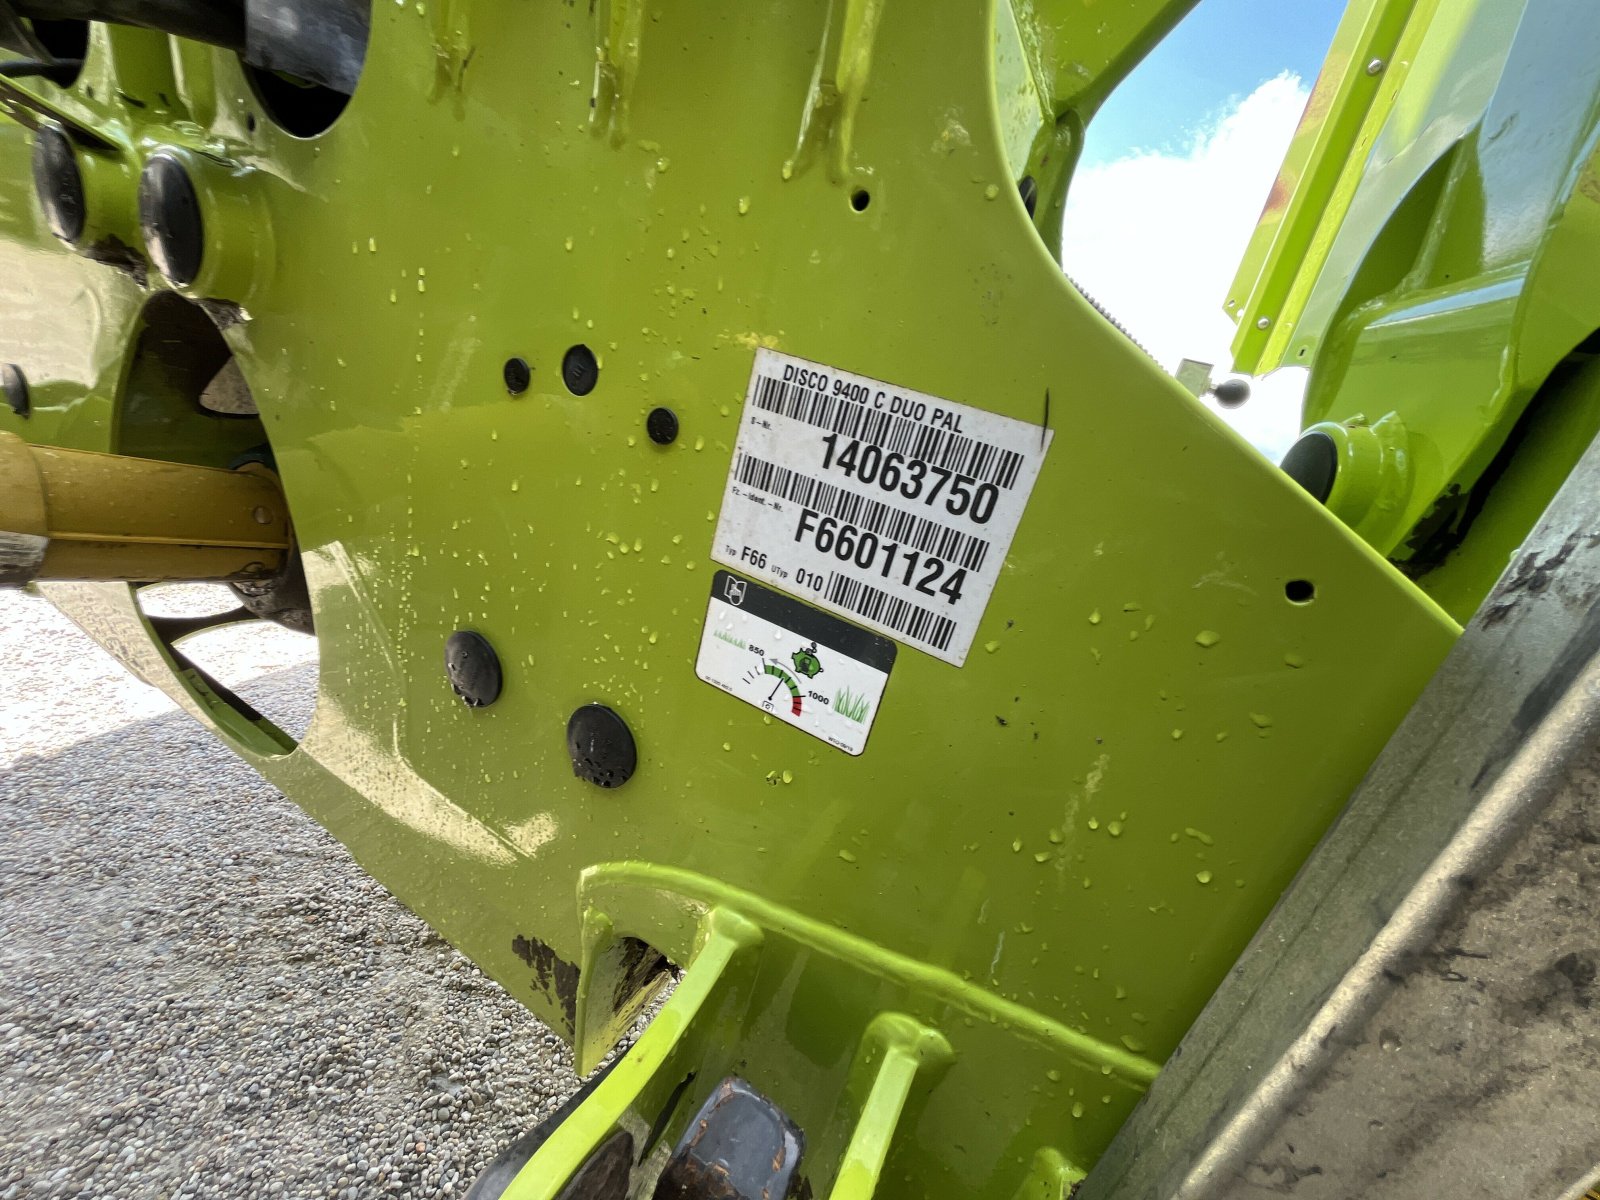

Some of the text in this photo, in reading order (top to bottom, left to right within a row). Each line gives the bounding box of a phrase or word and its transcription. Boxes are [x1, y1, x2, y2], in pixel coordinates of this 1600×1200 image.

[783, 364, 963, 433] DISCO 9400 C DUO PAL
[822, 433, 999, 524] 14063750
[725, 545, 737, 557] Typ
[741, 546, 768, 569] F66
[795, 568, 824, 592] 010
[794, 508, 967, 605] F6601124
[748, 644, 765, 657] 850
[807, 690, 830, 705] 1000
